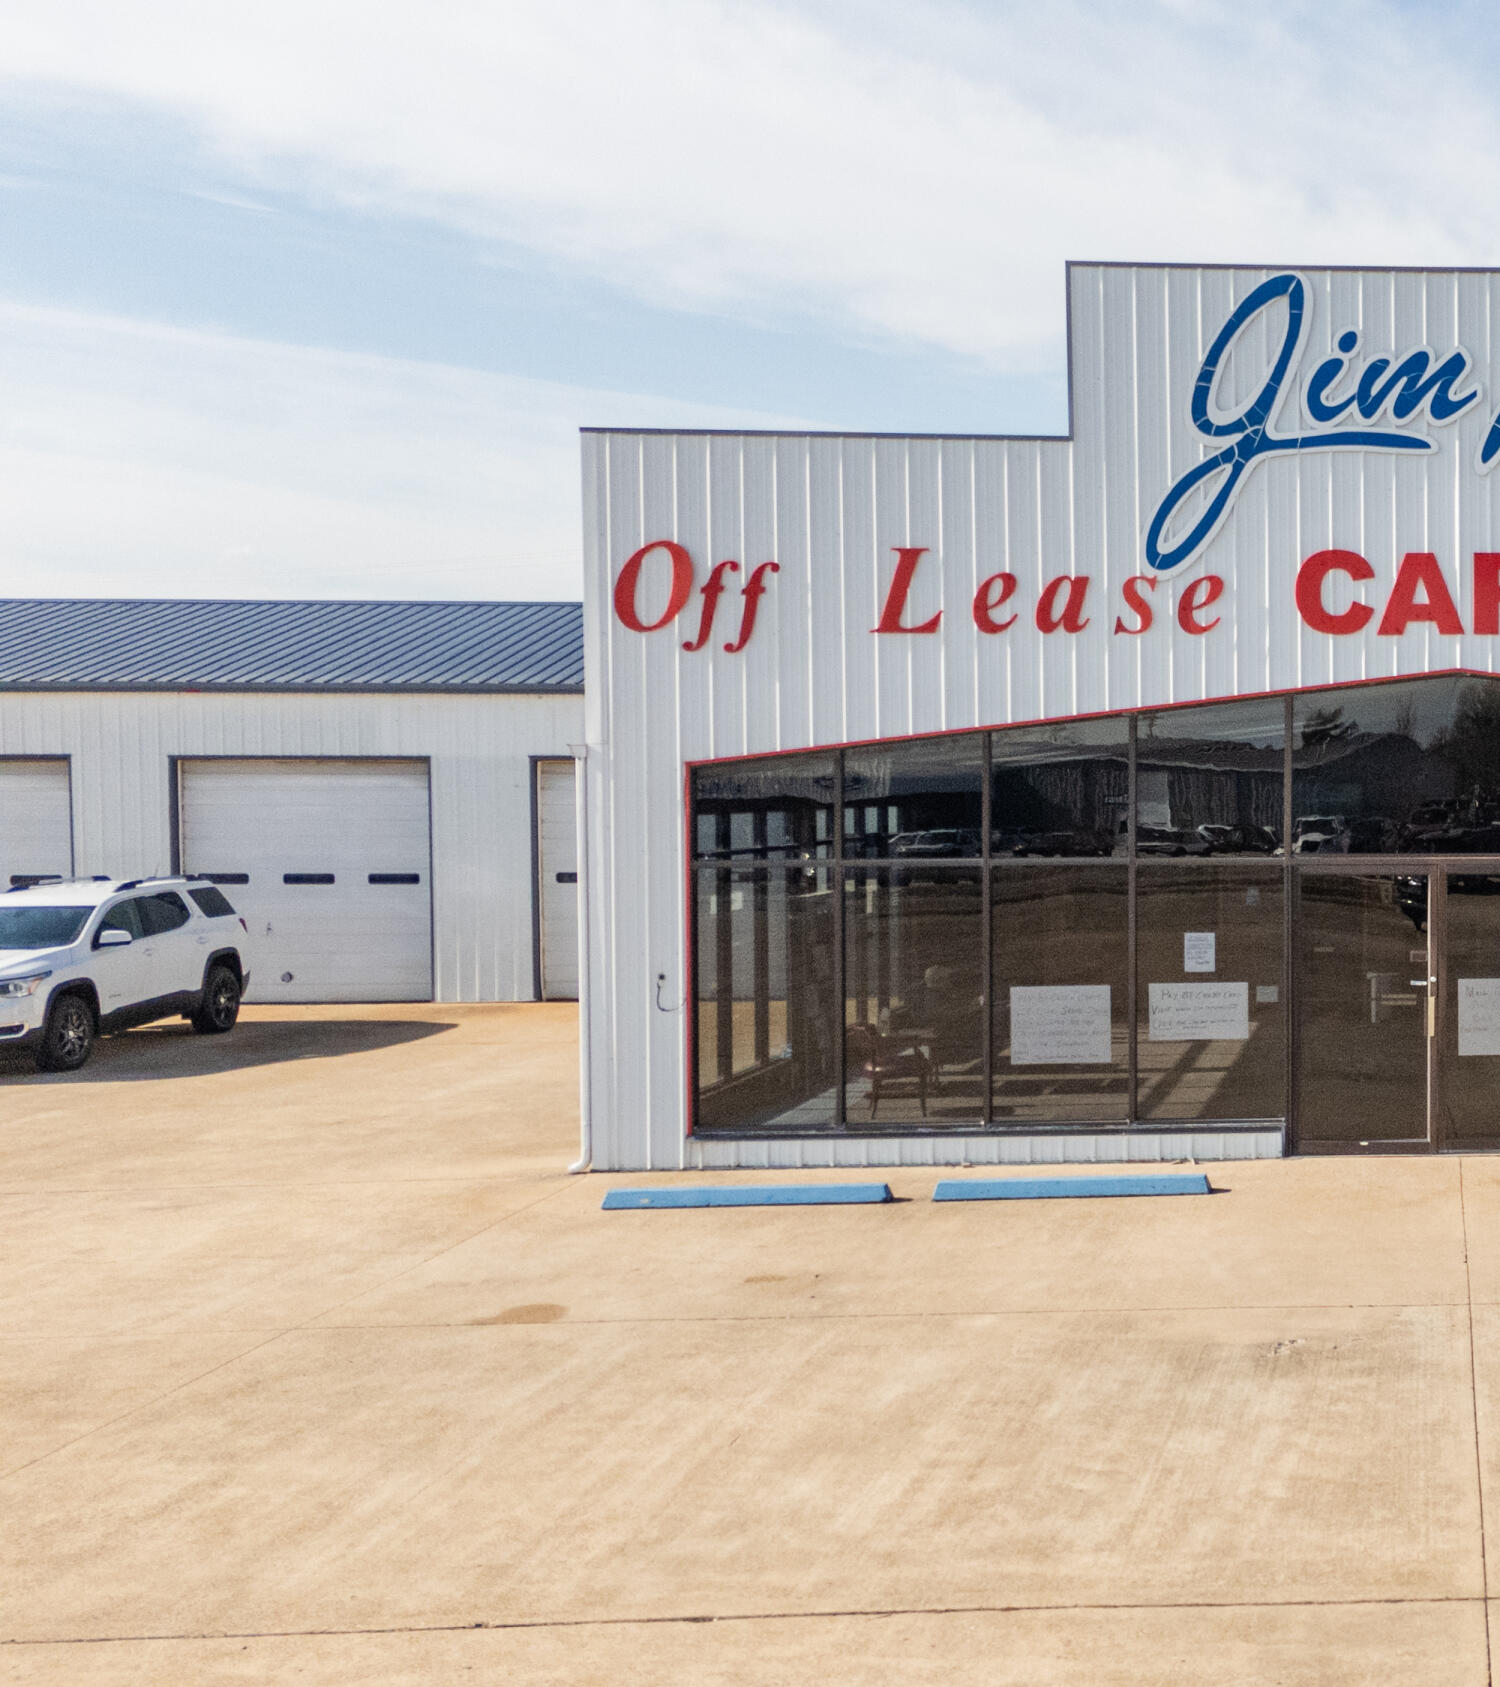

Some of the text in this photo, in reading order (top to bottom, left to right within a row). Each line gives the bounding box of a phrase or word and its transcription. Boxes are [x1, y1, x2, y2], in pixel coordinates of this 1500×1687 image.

[1145, 274, 1477, 570] Jim
[613, 540, 780, 653] Off
[870, 547, 1224, 635] Lease
